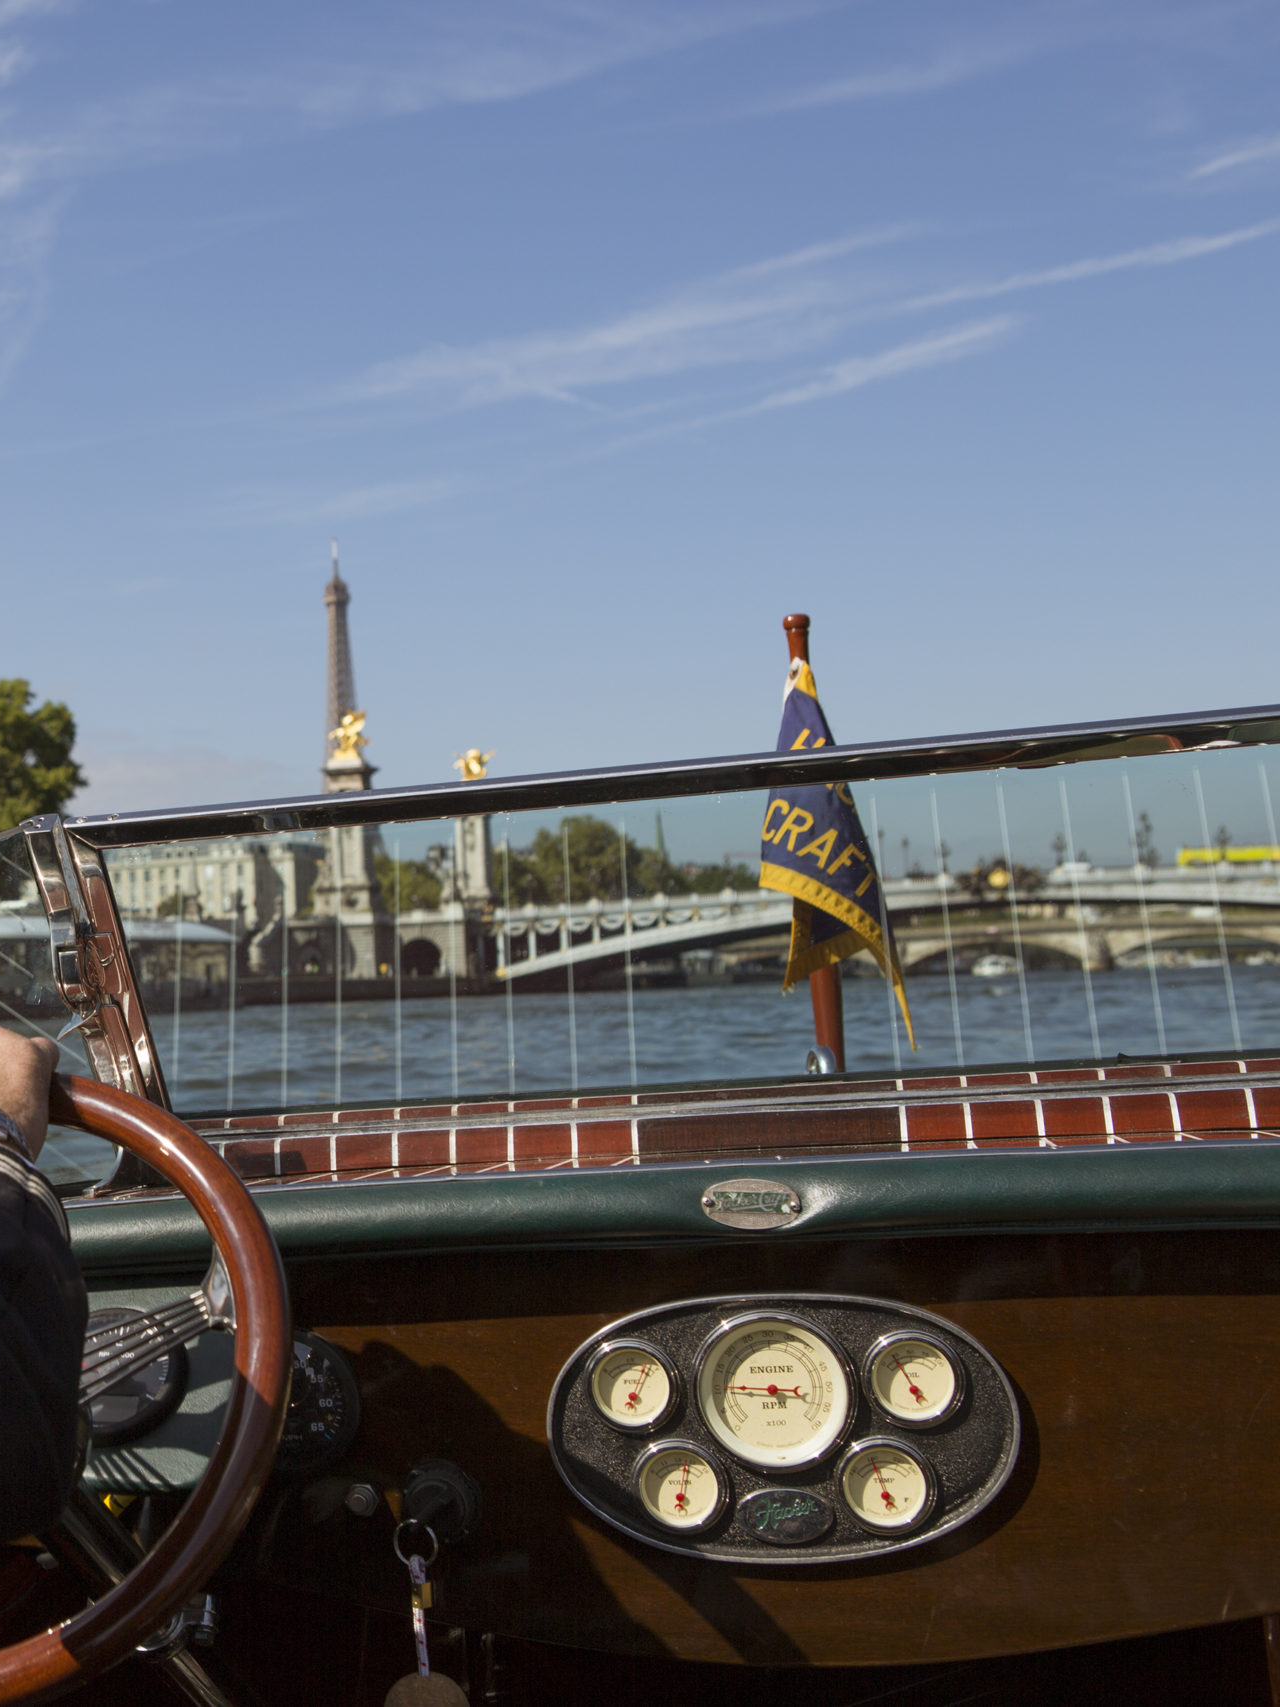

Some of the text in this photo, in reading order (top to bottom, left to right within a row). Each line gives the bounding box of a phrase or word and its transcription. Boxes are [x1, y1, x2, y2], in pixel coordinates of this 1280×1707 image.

[761, 798, 877, 897] CRAFT
[749, 1365, 794, 1374] ENGINE
[319, 1399, 333, 1407] 60
[762, 1401, 787, 1410] RPM
[311, 1422, 325, 1431] 65
